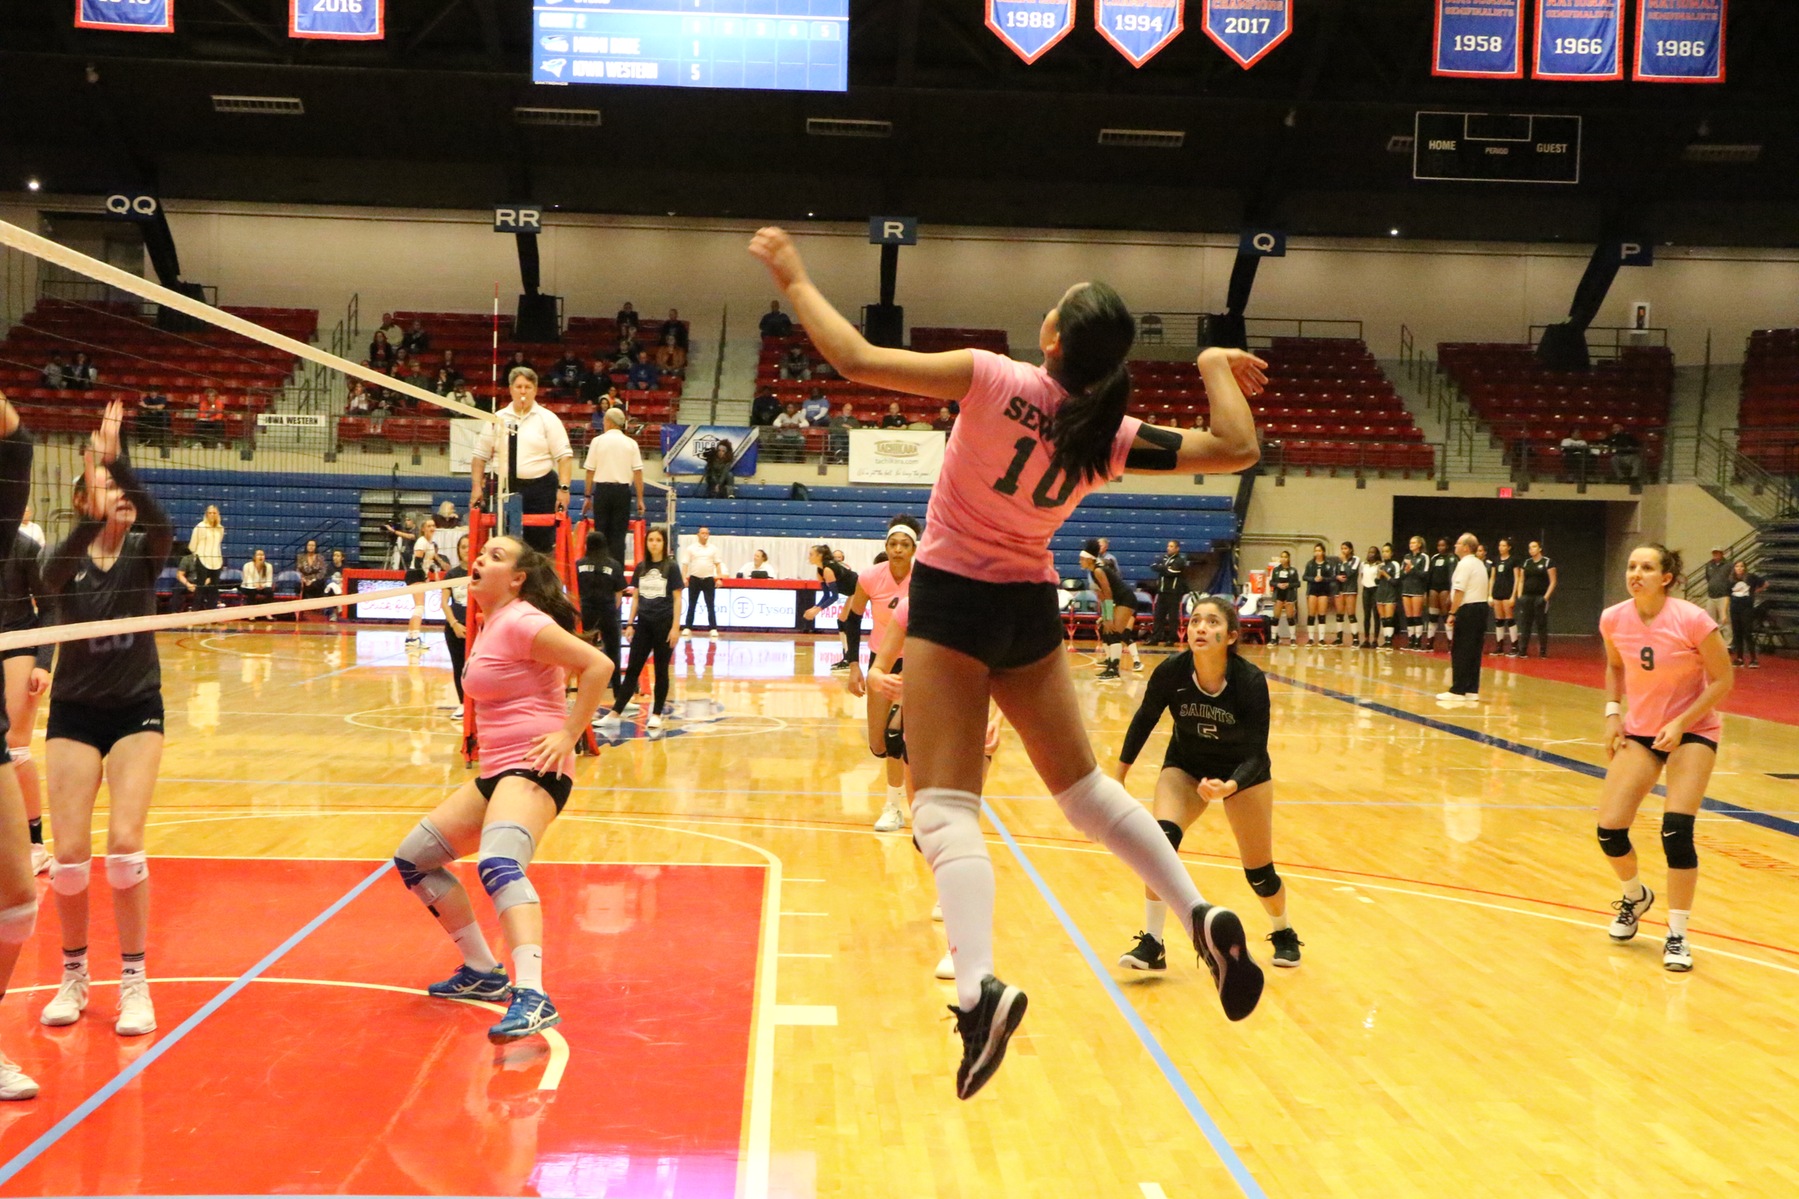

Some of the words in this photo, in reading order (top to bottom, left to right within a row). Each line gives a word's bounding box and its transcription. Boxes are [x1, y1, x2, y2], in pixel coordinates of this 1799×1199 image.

[312, 0, 363, 13] 2016
[1006, 11, 1056, 29] 1988
[1115, 14, 1163, 32] 1994
[1224, 17, 1271, 34] 2017
[1454, 35, 1502, 52] 1958
[1554, 37, 1603, 55] 1966
[1656, 40, 1706, 57] 1986
[690, 63, 701, 81] 5
[1428, 140, 1457, 150] HOME
[1536, 143, 1568, 153] GUEST
[106, 194, 157, 216] QQ
[495, 208, 540, 228] RR
[883, 221, 904, 239] R
[1252, 232, 1276, 253] Q
[1621, 243, 1641, 260] P
[264, 416, 284, 424] IOWA
[286, 416, 319, 425] WESTERN
[993, 436, 1080, 508] 10
[757, 603, 794, 616] Tyson
[1640, 646, 1655, 671] 9
[1179, 702, 1236, 725] SAINTS
[1197, 722, 1219, 740] 5
